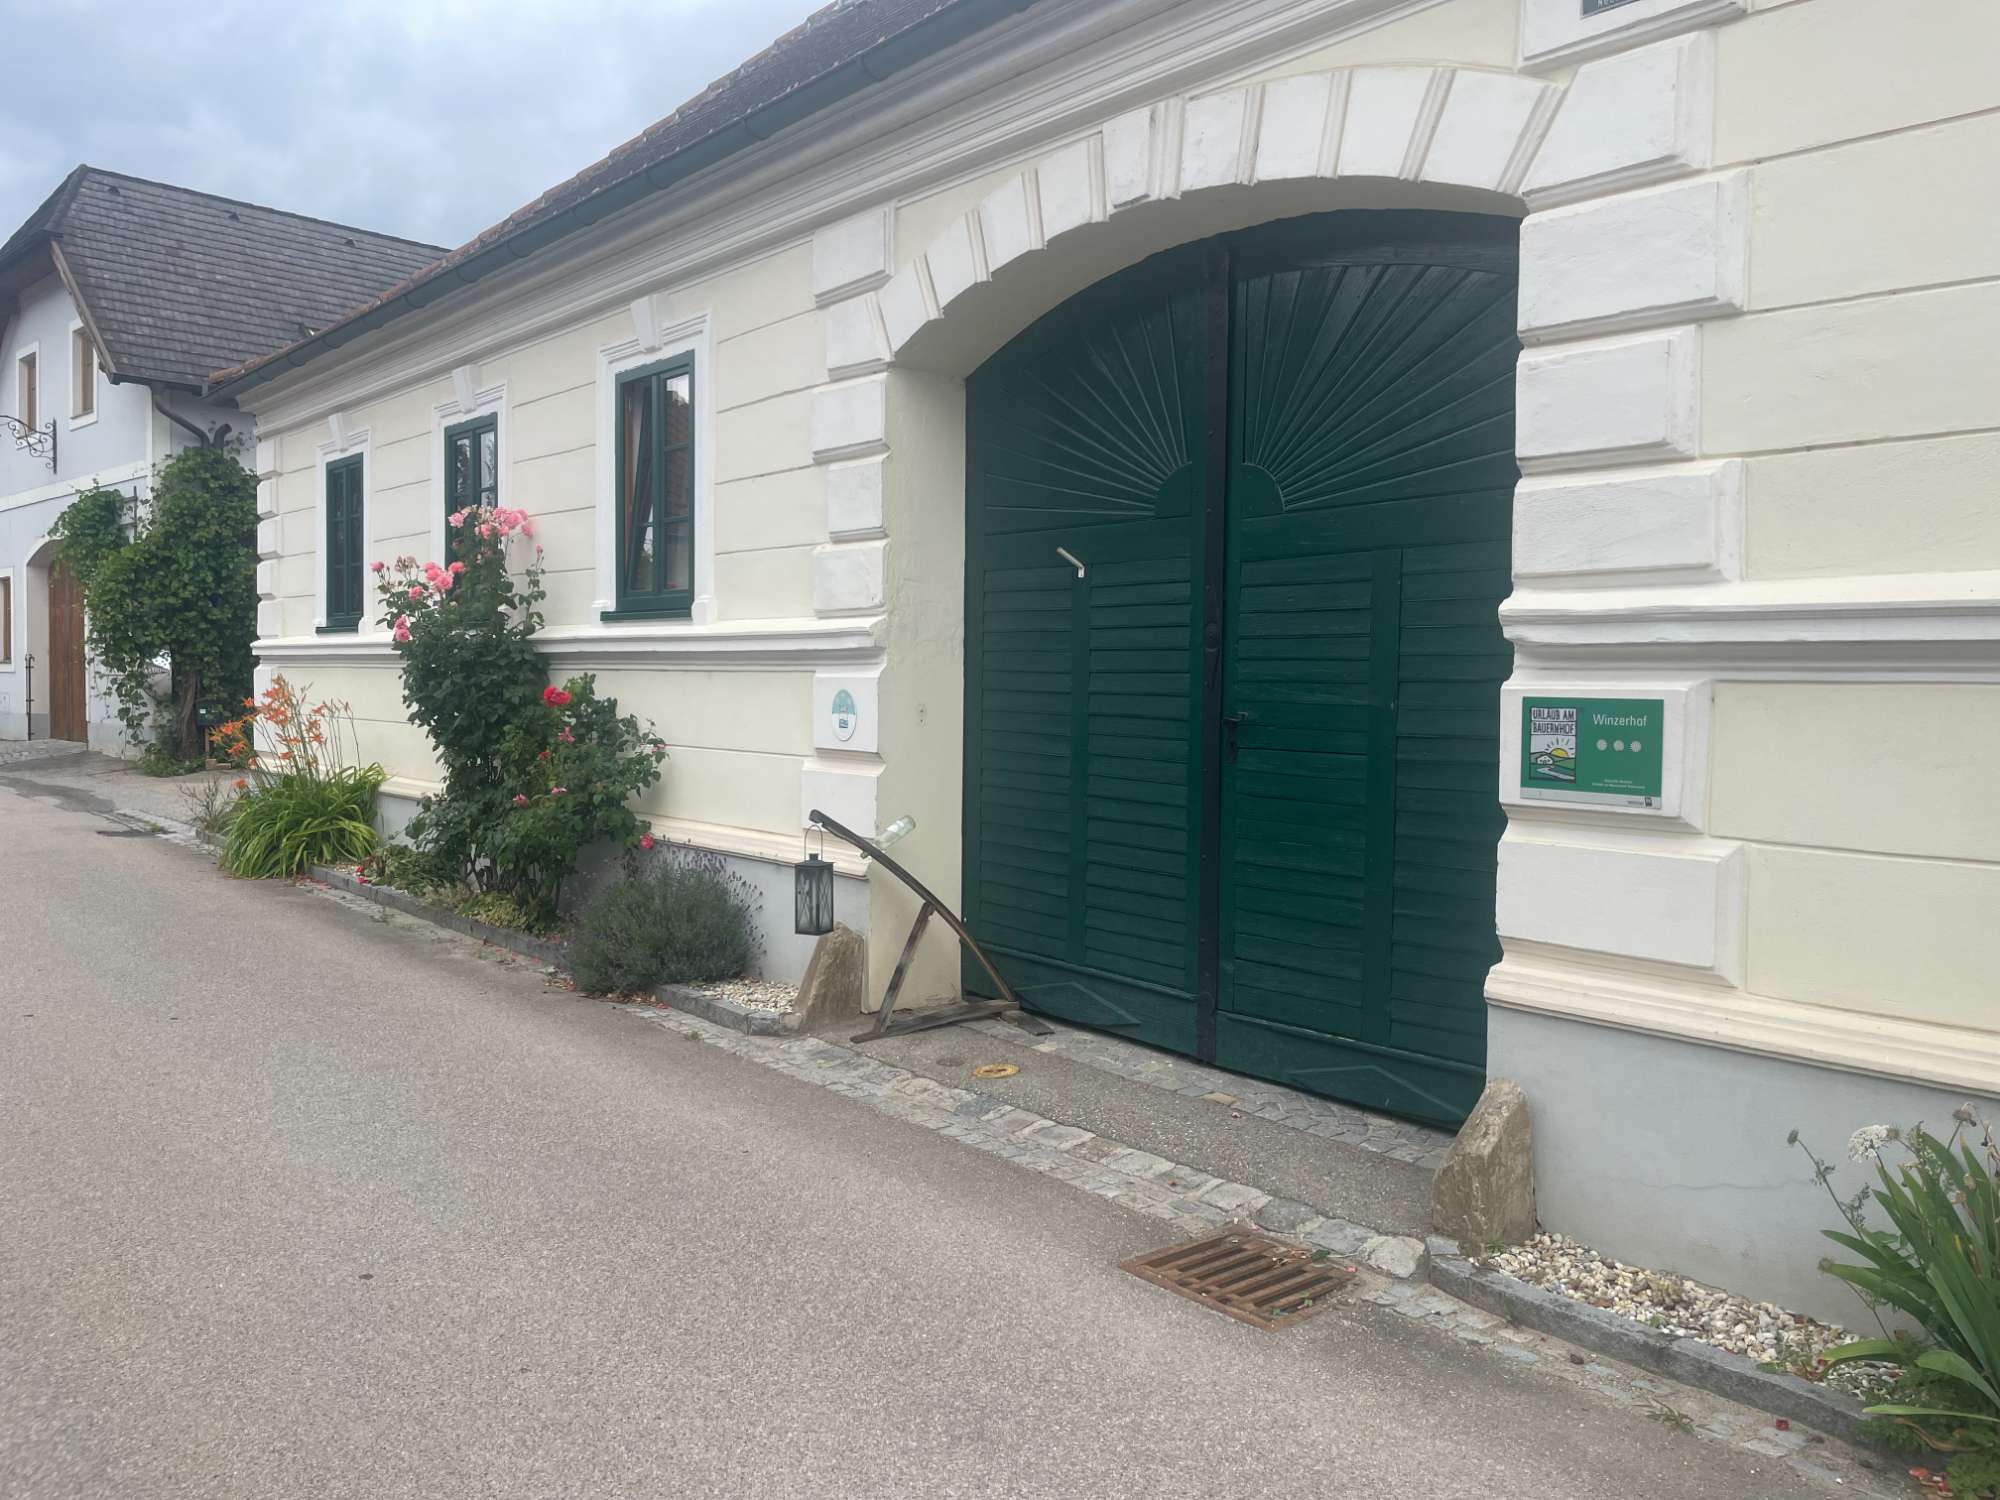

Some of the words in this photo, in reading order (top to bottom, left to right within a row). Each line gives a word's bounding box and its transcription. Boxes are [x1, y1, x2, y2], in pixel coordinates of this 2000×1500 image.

[1532, 709, 1560, 720] URLAUB
[1563, 710, 1575, 720] AM
[1592, 713, 1647, 727] Winzerhof
[1533, 722, 1574, 734] BAUERNHOF
